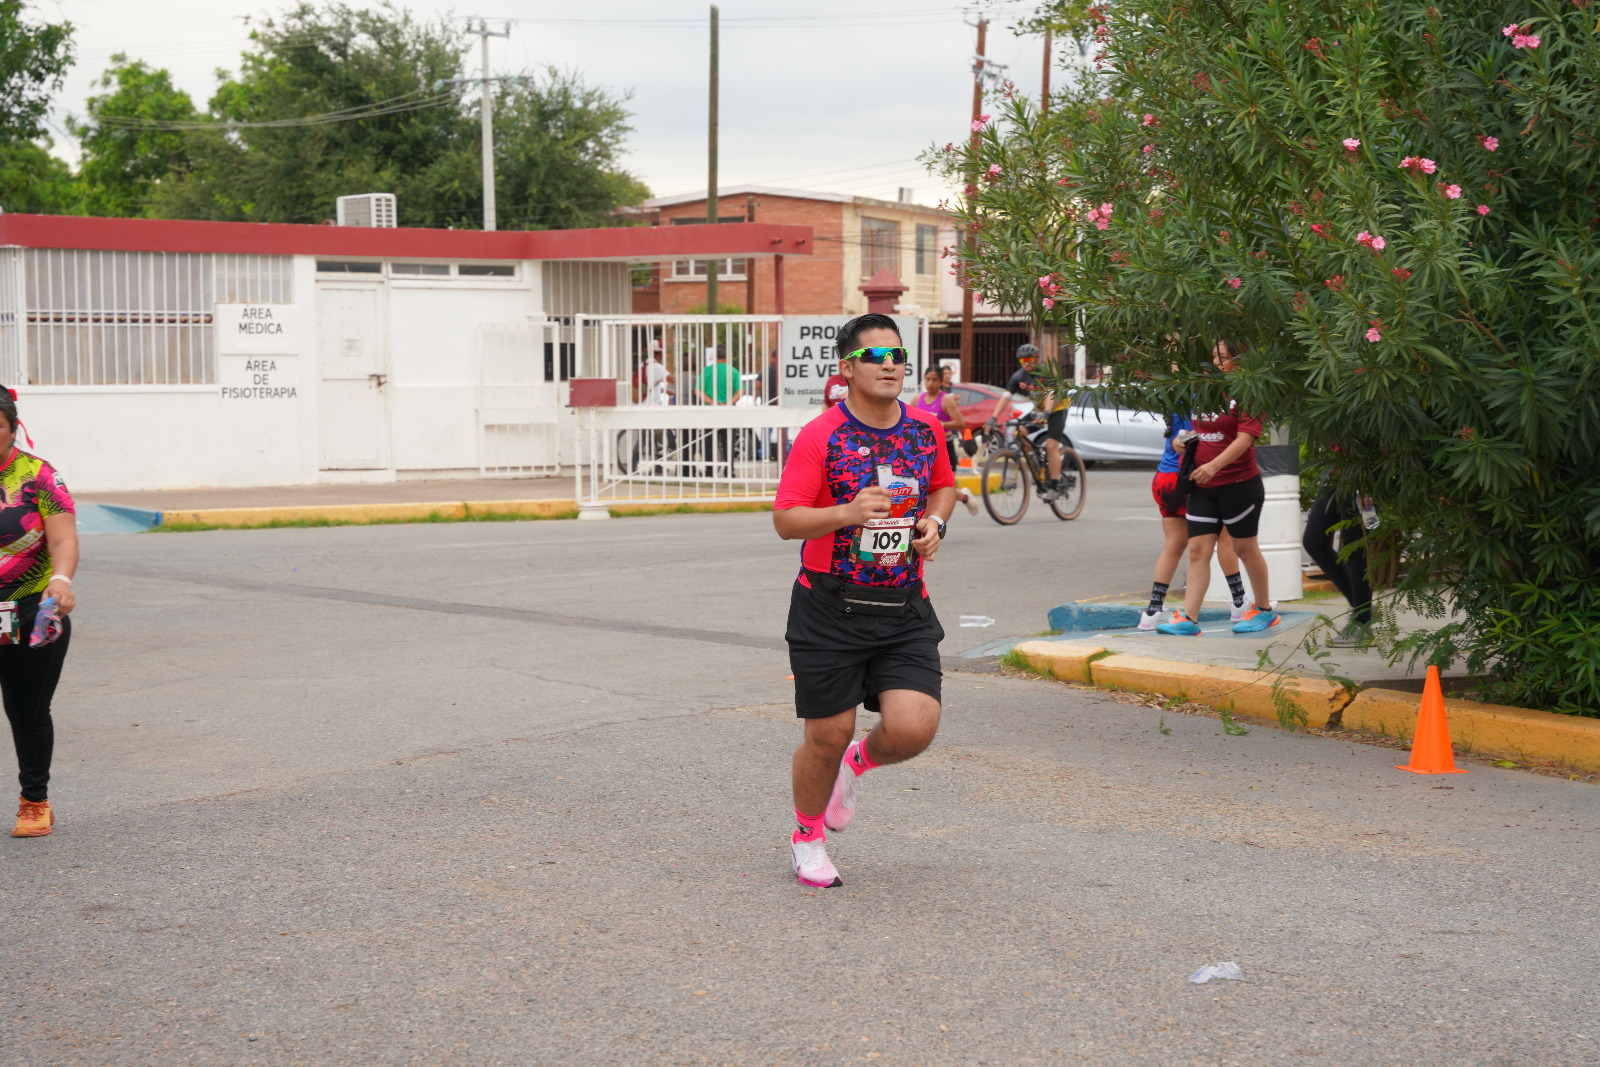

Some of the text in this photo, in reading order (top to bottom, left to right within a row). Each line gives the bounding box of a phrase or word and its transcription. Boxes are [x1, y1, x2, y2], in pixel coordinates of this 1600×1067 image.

[242, 305, 273, 319] ÁREA
[238, 321, 283, 334] MÉDICA
[800, 326, 840, 340] PRO
[792, 346, 840, 360] LA EN
[245, 356, 277, 372] ÁREA
[786, 364, 809, 378] DE
[815, 364, 838, 378] VE
[253, 374, 269, 385] DE
[221, 387, 297, 399] FISIOTERAPIA
[797, 387, 825, 395] estacio
[872, 531, 902, 550] 109
